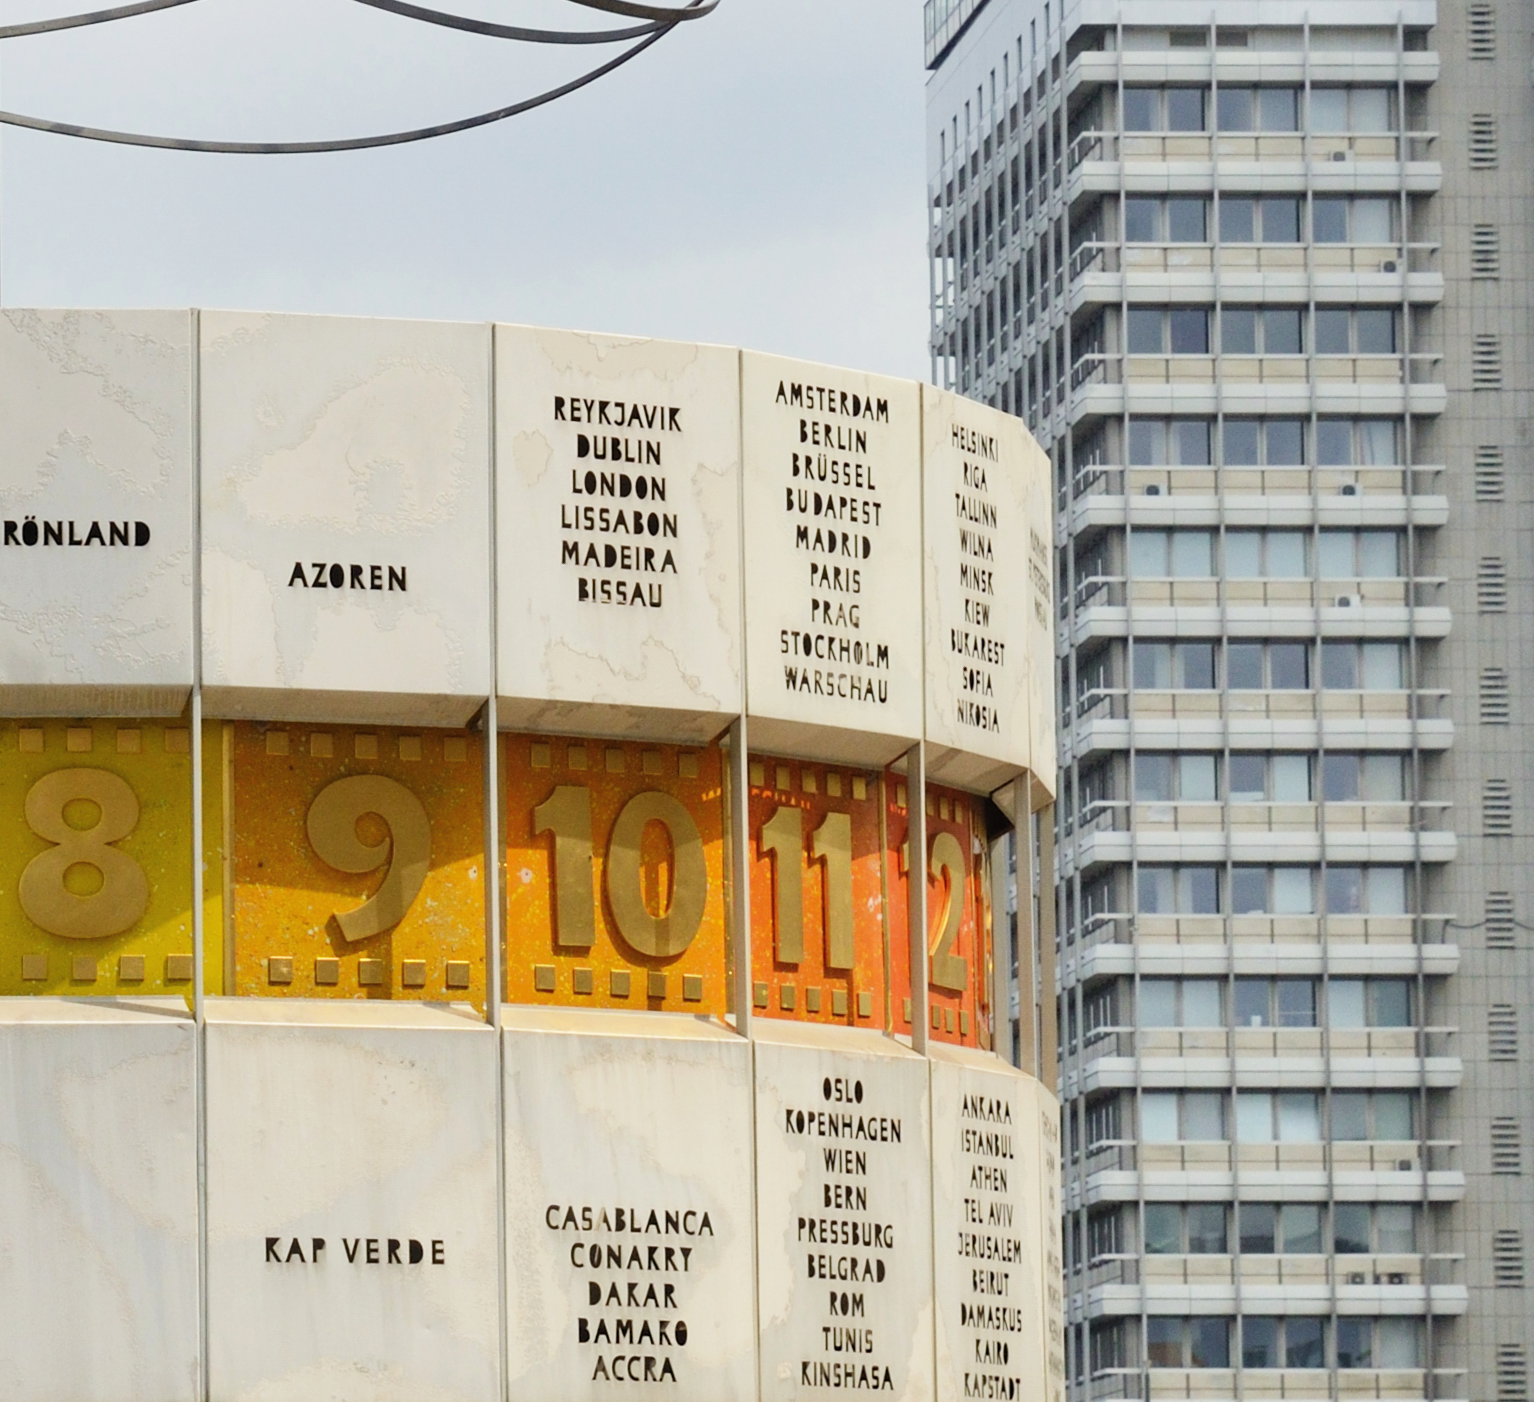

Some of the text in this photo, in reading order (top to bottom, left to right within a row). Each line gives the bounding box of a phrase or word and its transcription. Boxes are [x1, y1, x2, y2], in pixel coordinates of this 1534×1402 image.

[554, 396, 682, 432] REYKJAVIK
[775, 380, 889, 424] AMSTERDAM
[577, 433, 661, 466] DUBLIN
[799, 419, 867, 454] BERLIN
[952, 425, 1000, 463] HELSINKI
[572, 469, 666, 502] LONDON
[792, 452, 876, 491] BRÜSSEL
[963, 461, 987, 490] RIGA
[561, 504, 678, 538] LISSABON
[786, 487, 882, 526] BUDAPEST
[954, 492, 997, 529] TALLINN
[561, 540, 678, 574] MADEIRA
[796, 524, 871, 560] MADRID
[960, 530, 993, 558] WILNA
[288, 561, 407, 592] AZOREN
[810, 562, 861, 594] PARIS
[960, 563, 993, 593] MINSK
[578, 577, 662, 608] BISSAU
[811, 598, 860, 629] PRAG
[964, 598, 990, 626] KIEW
[780, 629, 889, 670] STOCKHOLM
[951, 628, 1005, 665] BUKAREST
[784, 665, 888, 704] WARSCHAU
[962, 666, 992, 698] SOFIA
[957, 702, 999, 733] NIKOSIA
[18, 767, 149, 939] 8
[305, 773, 432, 942] 9
[534, 784, 708, 957] 10
[761, 805, 855, 970] 11
[903, 832, 967, 991] 2
[822, 1077, 864, 1104] OSLO
[962, 1095, 1011, 1122] ANKARA
[785, 1109, 901, 1143] KOPENHAGEN
[960, 1128, 1014, 1160] ISTANBUL
[823, 1147, 866, 1176] WIEN
[971, 1165, 1007, 1192] ATHEN
[823, 1183, 867, 1211] BERN
[545, 1204, 714, 1237] CASABLANCA
[963, 1198, 1013, 1228] TEL AVIV
[798, 1217, 893, 1249] PRESSBURG
[958, 1232, 1021, 1263] JERUSALEM
[265, 1237, 445, 1265] KAP VERDE
[570, 1242, 692, 1272] CONAKRY
[807, 1253, 886, 1283] BELGRAD
[972, 1269, 1010, 1296] BEIRUT
[588, 1281, 678, 1309] DAKAR
[829, 1291, 865, 1318] ROM
[578, 1317, 688, 1347] BAMAKO
[960, 1302, 1022, 1333] DAMASKUS
[822, 1326, 873, 1354] TUNIS
[975, 1338, 1009, 1365] KAIRO
[592, 1355, 677, 1383] ACCRA
[801, 1361, 894, 1391] KINSHASA
[964, 1372, 1021, 1401] KAPSTADT
